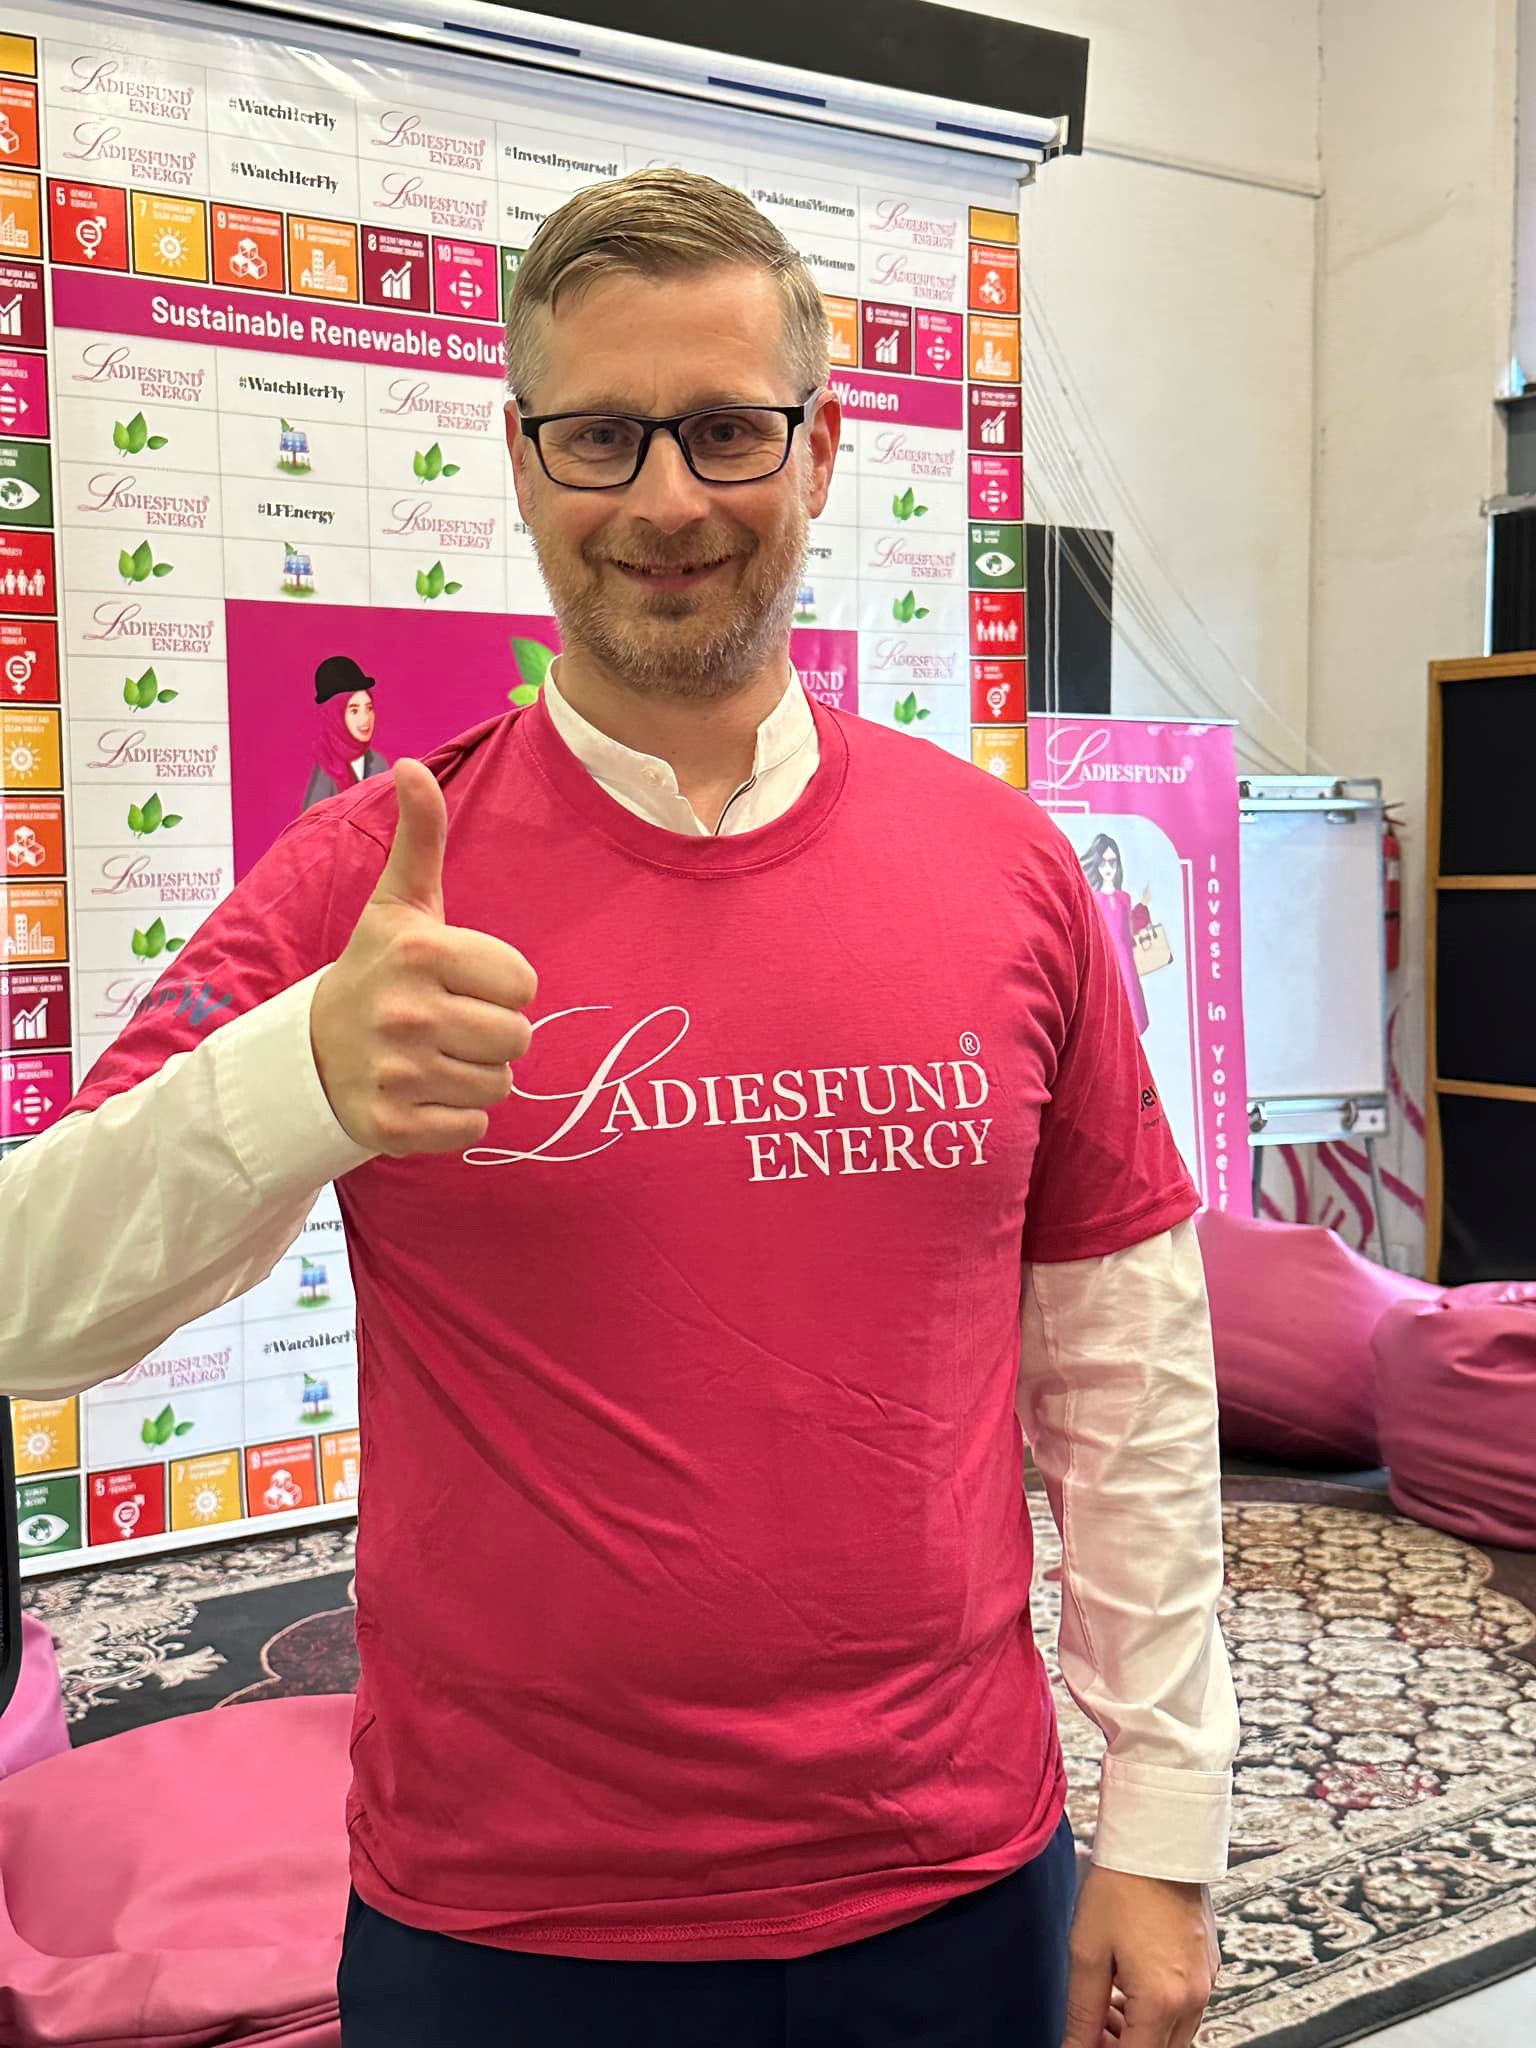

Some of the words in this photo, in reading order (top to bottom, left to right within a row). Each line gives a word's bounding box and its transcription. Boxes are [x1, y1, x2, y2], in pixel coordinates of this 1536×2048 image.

[129, 98, 191, 120] ENERGY
[229, 98, 337, 131] #WatchHerFly
[430, 150, 483, 171] ENERGY
[131, 164, 193, 185] ENERGY
[230, 162, 338, 194] #WatchHerFly
[55, 186, 66, 206] 5
[139, 198, 148, 217] 7
[217, 211, 226, 229] 9
[431, 211, 485, 231] ENERGY
[151, 296, 304, 341] Sustainable
[310, 317, 441, 358] Renewable
[447, 334, 506, 366] Solut
[140, 382, 202, 401] ENERGY
[239, 375, 346, 403] #WatchHerFly
[831, 381, 899, 412] Women
[437, 415, 490, 432] ENERGY
[146, 511, 207, 528] ENERGY
[257, 502, 335, 525] #LFEnergy
[439, 534, 493, 549] ENERGY
[151, 637, 211, 653] ENERGY
[155, 763, 216, 778] ENERGY
[160, 888, 220, 902] ENERGY
[1207, 1001, 1226, 1021] in
[746, 1118, 993, 1182] ENERGY
[168, 1367, 228, 1388] ENERGY
